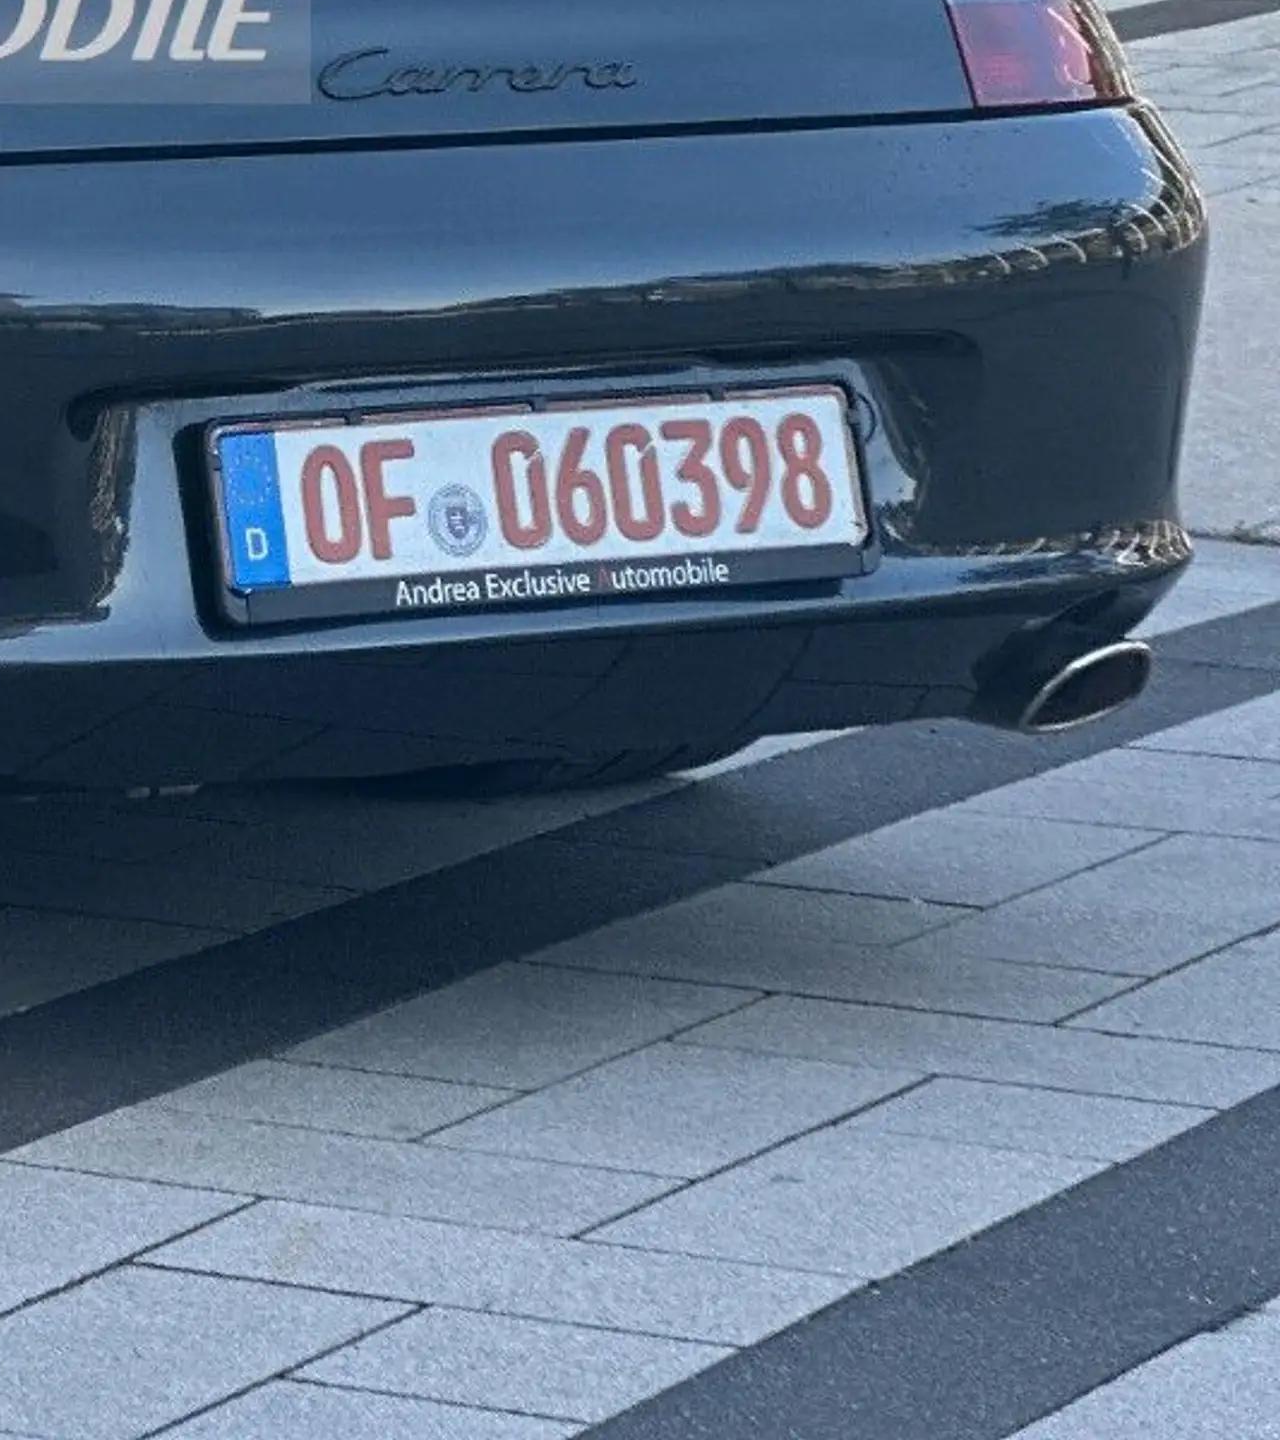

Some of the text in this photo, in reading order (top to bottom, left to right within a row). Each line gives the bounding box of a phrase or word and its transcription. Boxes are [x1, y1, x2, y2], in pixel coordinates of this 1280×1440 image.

[318, 48, 638, 101] Carrera
[301, 438, 416, 565] OF
[492, 412, 833, 550] 060398
[245, 527, 269, 561] D
[396, 575, 481, 607] Andrea
[485, 567, 591, 600] Exclusive
